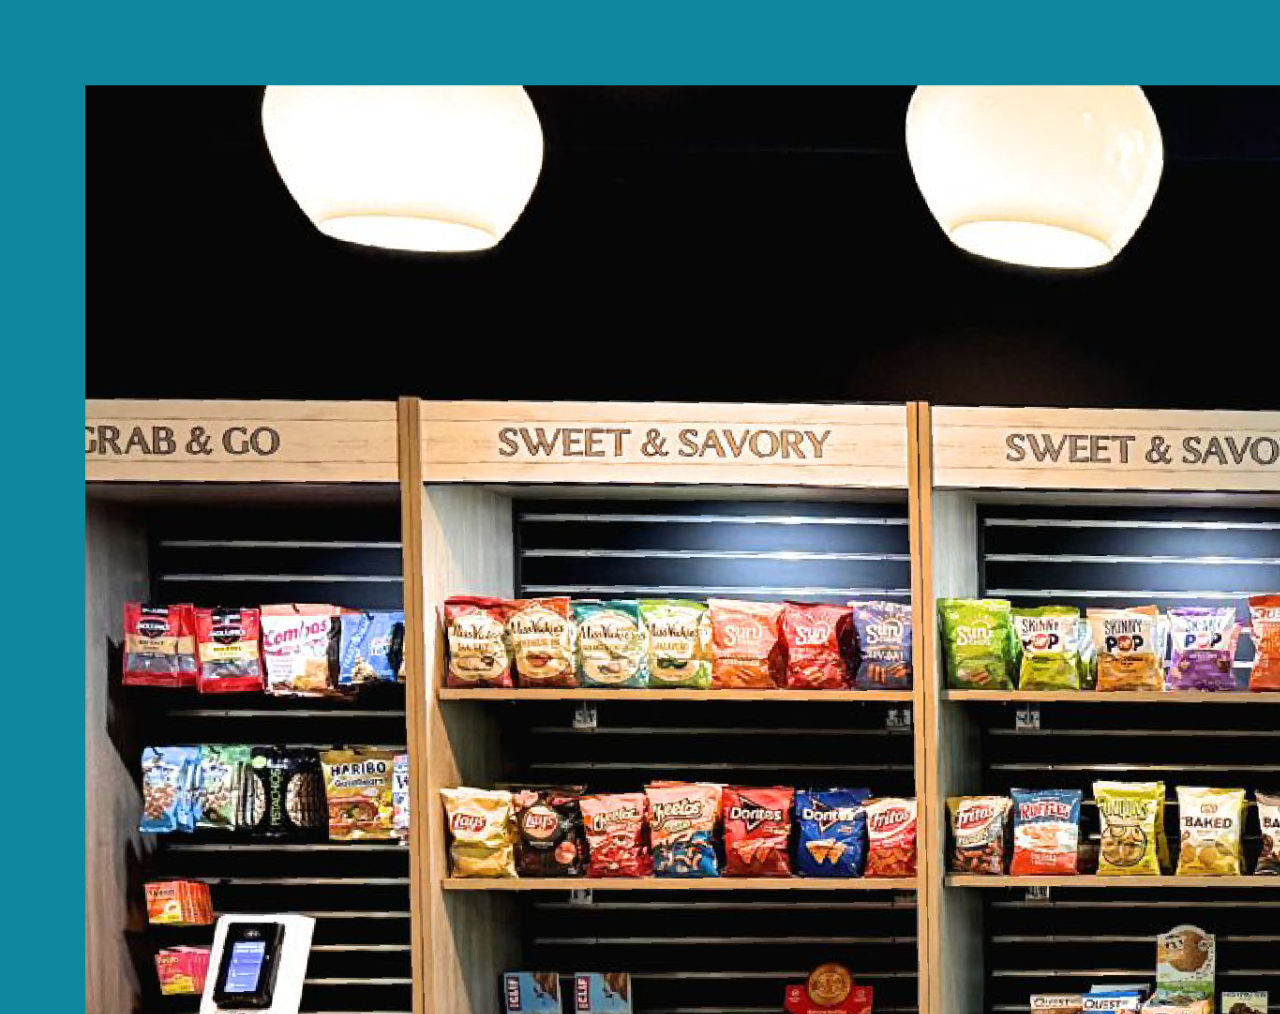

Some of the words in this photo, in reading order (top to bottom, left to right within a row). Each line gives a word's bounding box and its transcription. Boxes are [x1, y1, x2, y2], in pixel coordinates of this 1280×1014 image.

[185, 426, 213, 456] &
[222, 426, 280, 456] GO
[498, 428, 631, 457] SWEET
[641, 429, 670, 457] &
[678, 429, 831, 459] SAVORY
[1006, 434, 1136, 464] SWEET
[1145, 436, 1172, 465] &
[1104, 618, 1143, 635] SKINNY
[1105, 635, 1145, 652] POP
[331, 761, 386, 777] HARIBO
[731, 806, 783, 821] Doritos
[1185, 816, 1232, 829] BAKED
[1084, 999, 1121, 1010] QUEST
